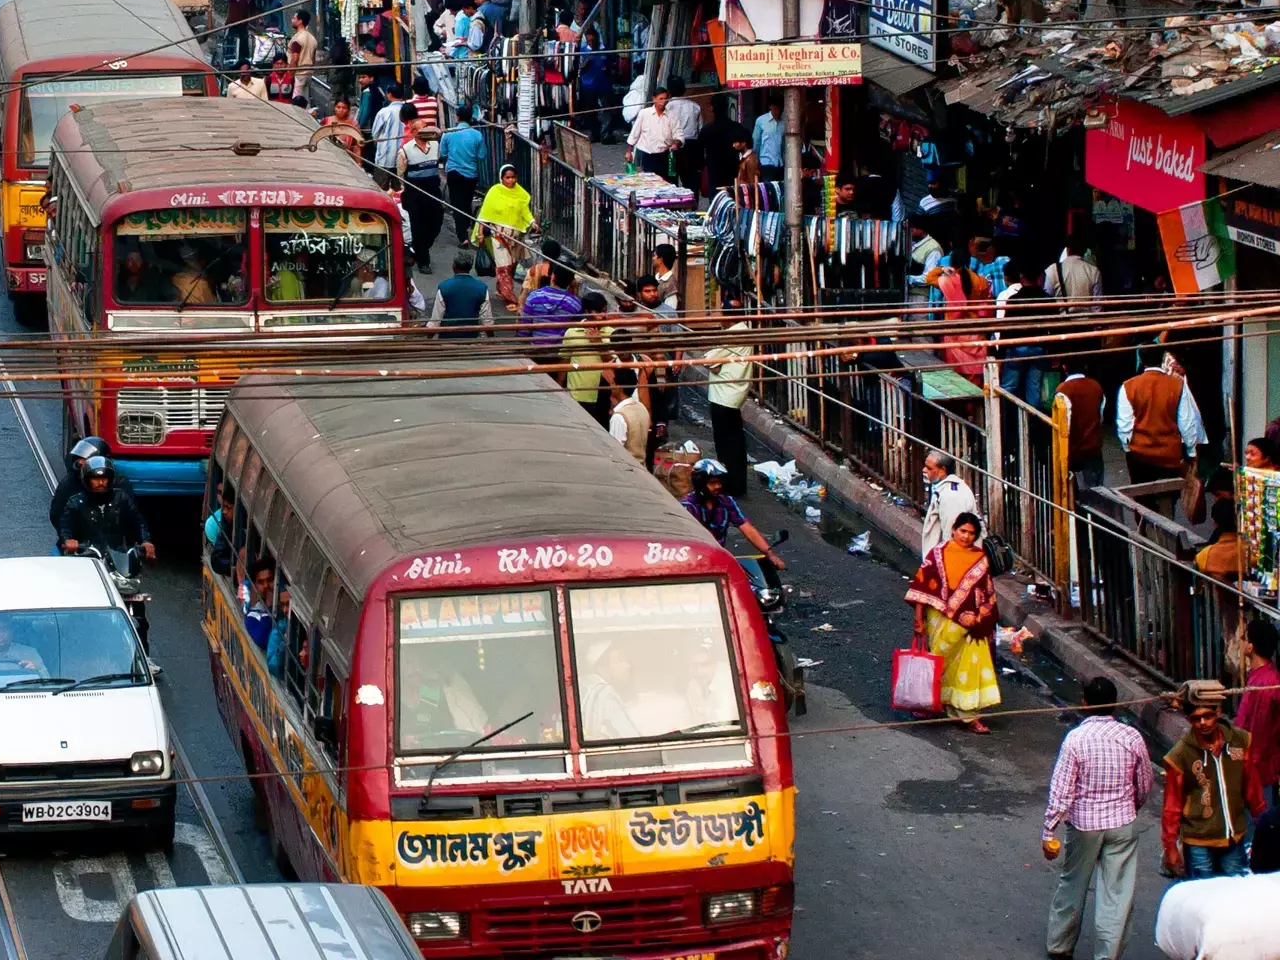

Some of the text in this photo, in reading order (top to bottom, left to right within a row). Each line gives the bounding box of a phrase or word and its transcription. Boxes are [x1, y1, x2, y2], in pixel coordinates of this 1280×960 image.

[727, 46, 860, 63] Madanji Meghraj & Co.
[895, 36, 929, 60] STORES
[777, 62, 813, 71] Jewellers
[1127, 127, 1195, 183] just baked
[313, 192, 345, 207] Bus
[1255, 233, 1277, 253] STORES
[272, 261, 308, 272] ANDUL
[643, 542, 690, 565] Bus
[401, 593, 546, 630] ALAMPUR
[398, 829, 543, 871] আলমপুর
[557, 824, 610, 866] হাওড়া
[562, 878, 613, 895] TATA
